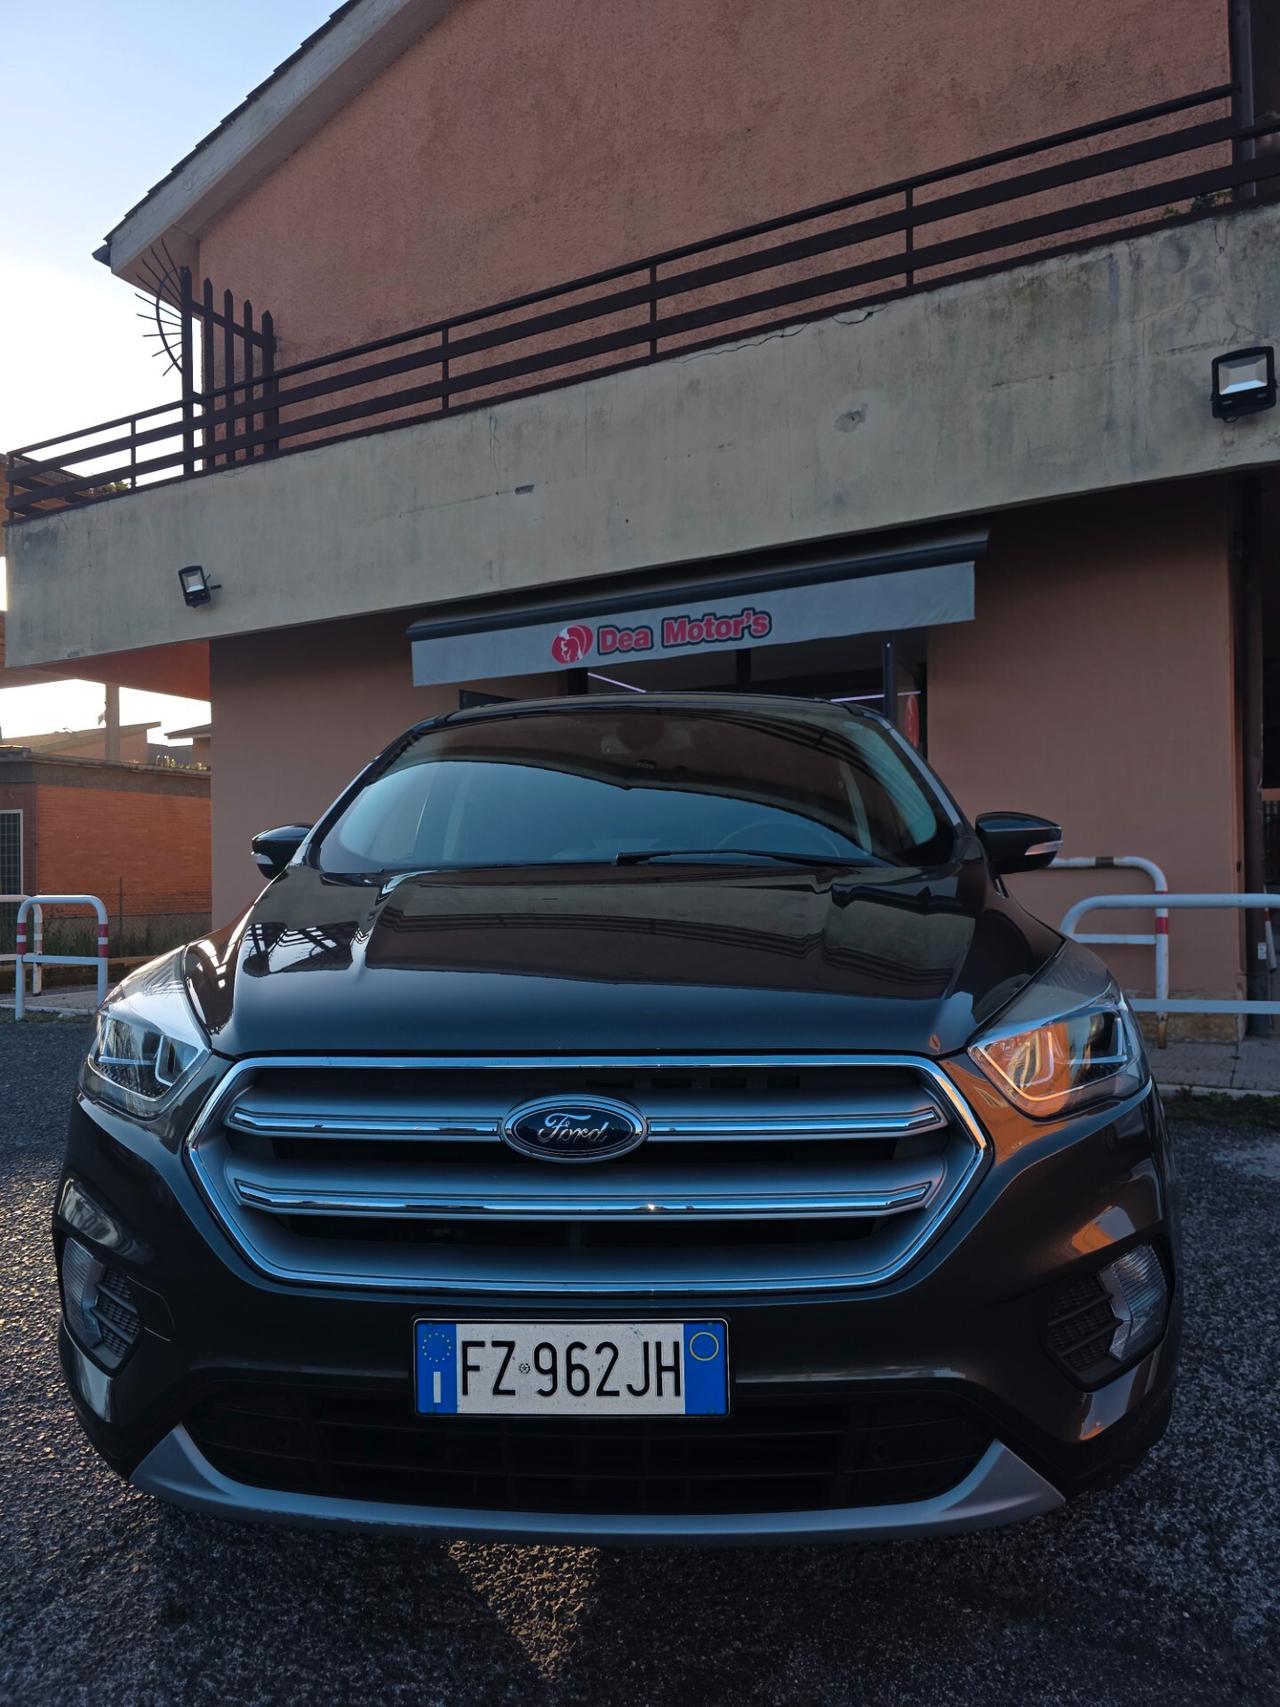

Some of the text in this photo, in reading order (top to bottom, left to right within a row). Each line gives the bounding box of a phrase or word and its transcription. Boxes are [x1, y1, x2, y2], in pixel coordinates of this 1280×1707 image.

[597, 608, 772, 654] Dea Motor's
[537, 1112, 610, 1144] Ford
